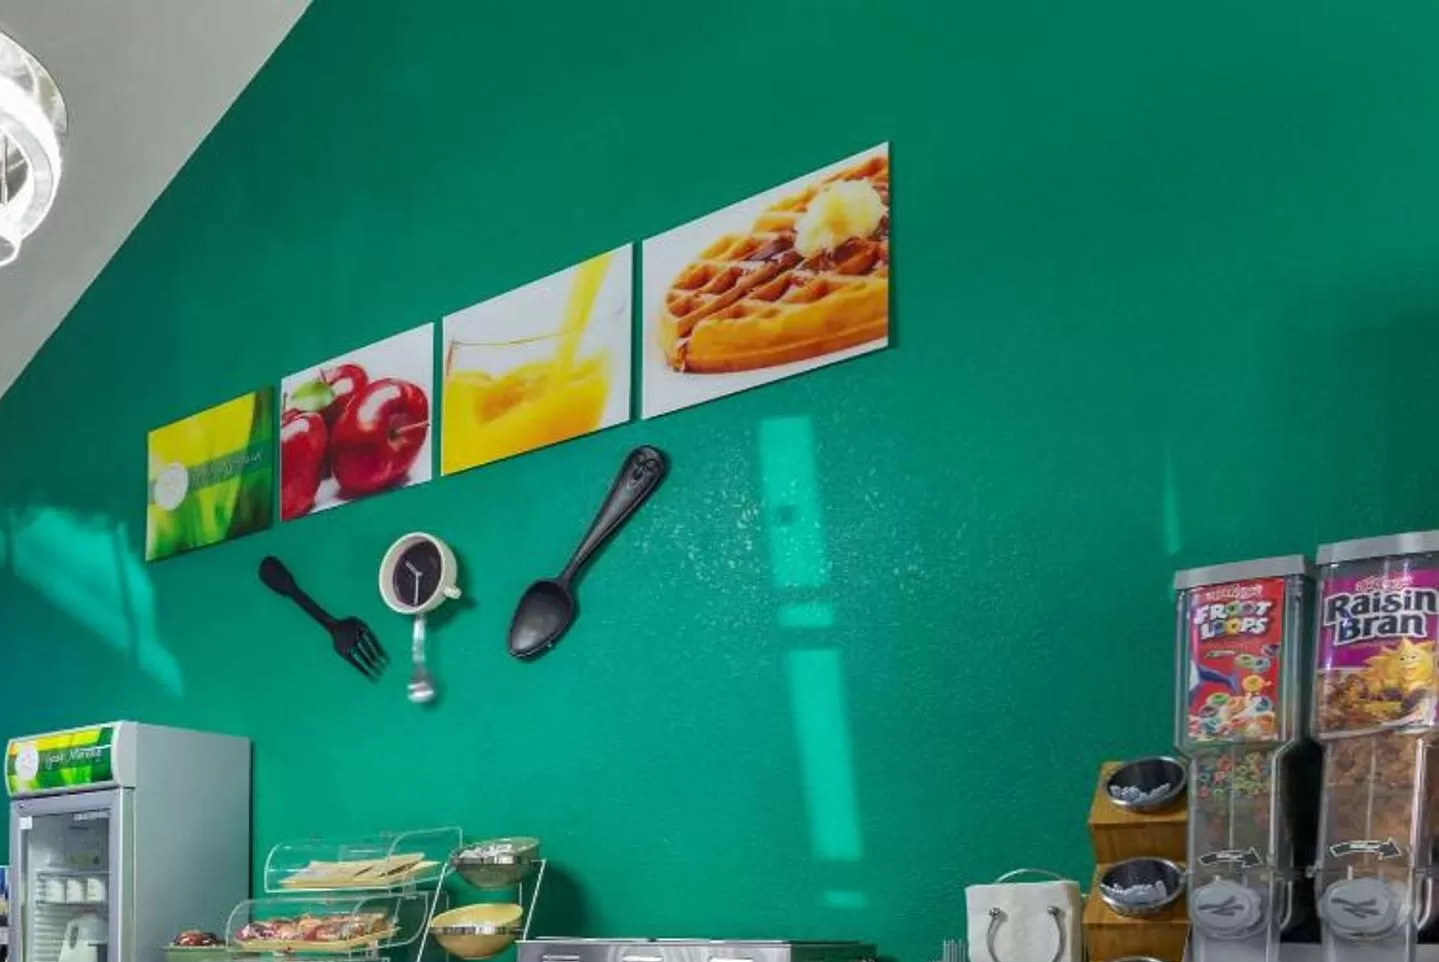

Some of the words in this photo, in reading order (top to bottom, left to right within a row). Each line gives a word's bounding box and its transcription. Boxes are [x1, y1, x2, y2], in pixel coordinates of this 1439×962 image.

[1193, 601, 1272, 624] FROOT
[1324, 588, 1438, 626] Raisin
[1201, 617, 1268, 640] LOOPS
[1334, 613, 1426, 644] Bran
